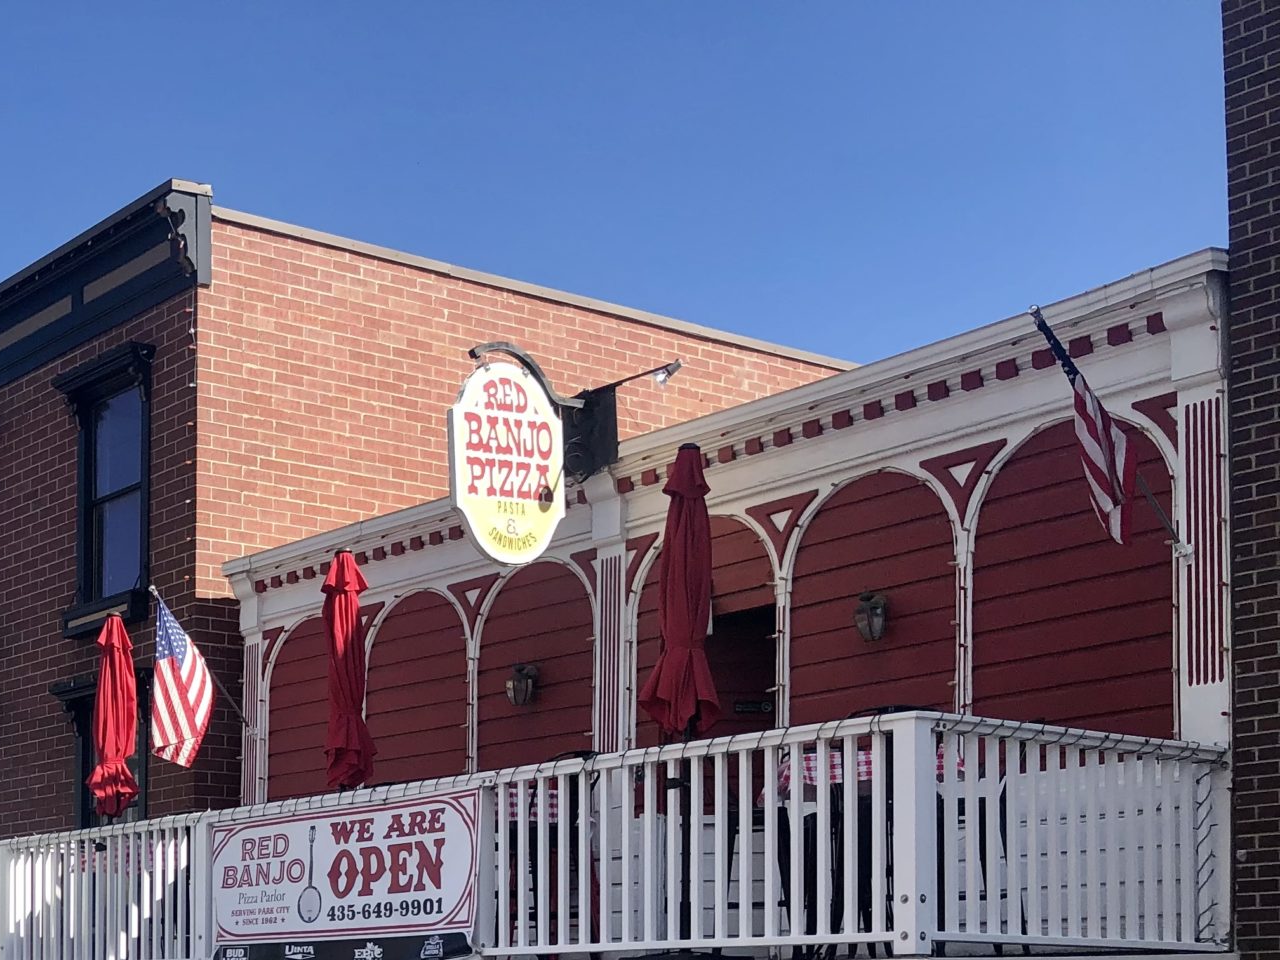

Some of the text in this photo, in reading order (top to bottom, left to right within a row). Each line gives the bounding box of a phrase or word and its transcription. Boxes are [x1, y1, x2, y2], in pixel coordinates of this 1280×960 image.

[483, 377, 528, 413] RED
[464, 412, 553, 461] BANJO
[466, 456, 550, 502] PIZZA
[497, 500, 526, 516] PASTA
[488, 527, 537, 551] SANDWICHES
[329, 807, 446, 845] WE ARE
[240, 833, 290, 861] RED
[221, 858, 306, 889] BANJO
[327, 838, 445, 899] OPEN
[238, 889, 286, 905] Pizza Parlor
[327, 897, 443, 921] 435-649-9901
[231, 906, 290, 917] SERVING PARK CITY
[242, 918, 259, 926] SINCE
[226, 948, 244, 958] BUD
